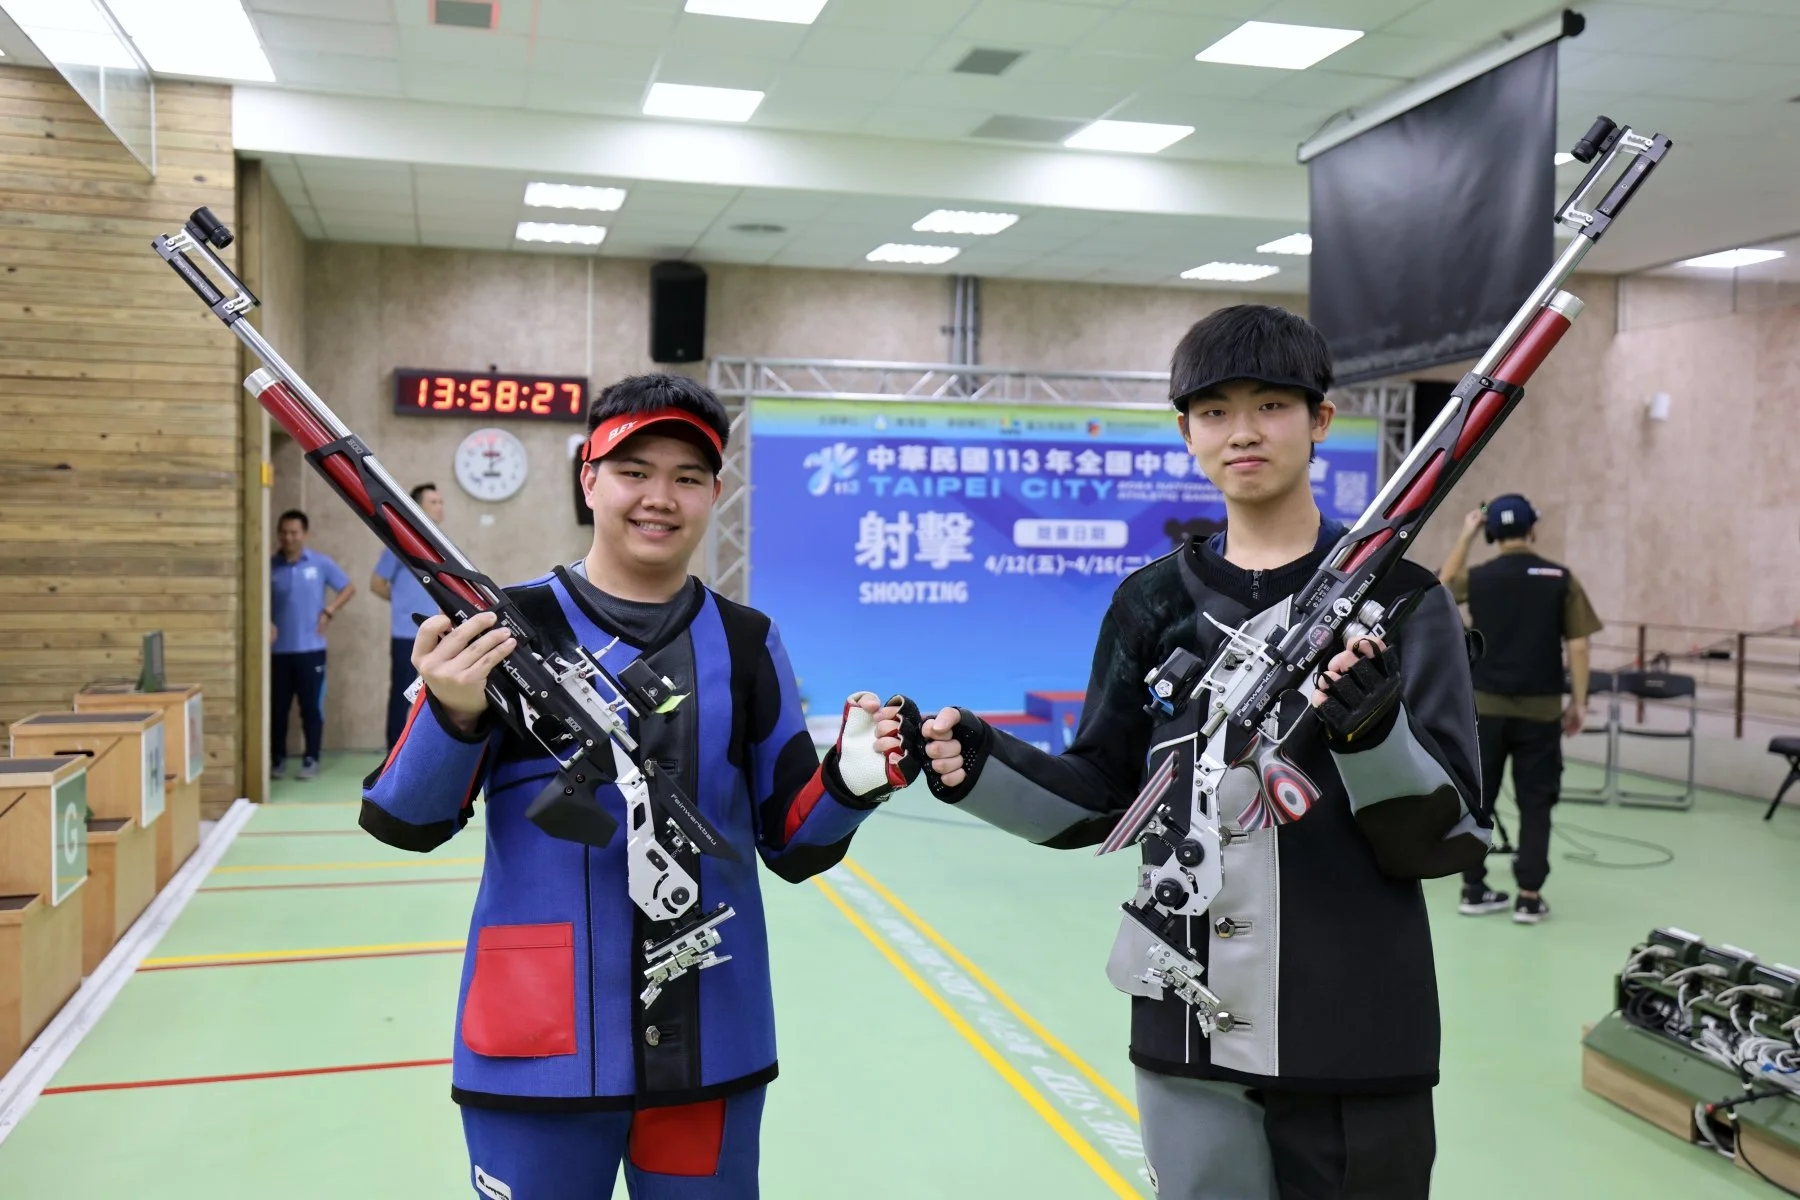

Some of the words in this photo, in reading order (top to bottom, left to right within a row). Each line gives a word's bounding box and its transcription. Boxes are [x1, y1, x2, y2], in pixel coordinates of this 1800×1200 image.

[417, 376, 582, 415] 13:58:27
[868, 476, 1000, 498] TAIPEI
[1021, 478, 1114, 499] CITY
[855, 510, 974, 570] 射擊
[859, 581, 969, 604] SHOOTING
[1236, 660, 1283, 717] Feinwerkbau
[64, 802, 79, 865] G
[670, 792, 717, 847] Feinwerkbau
